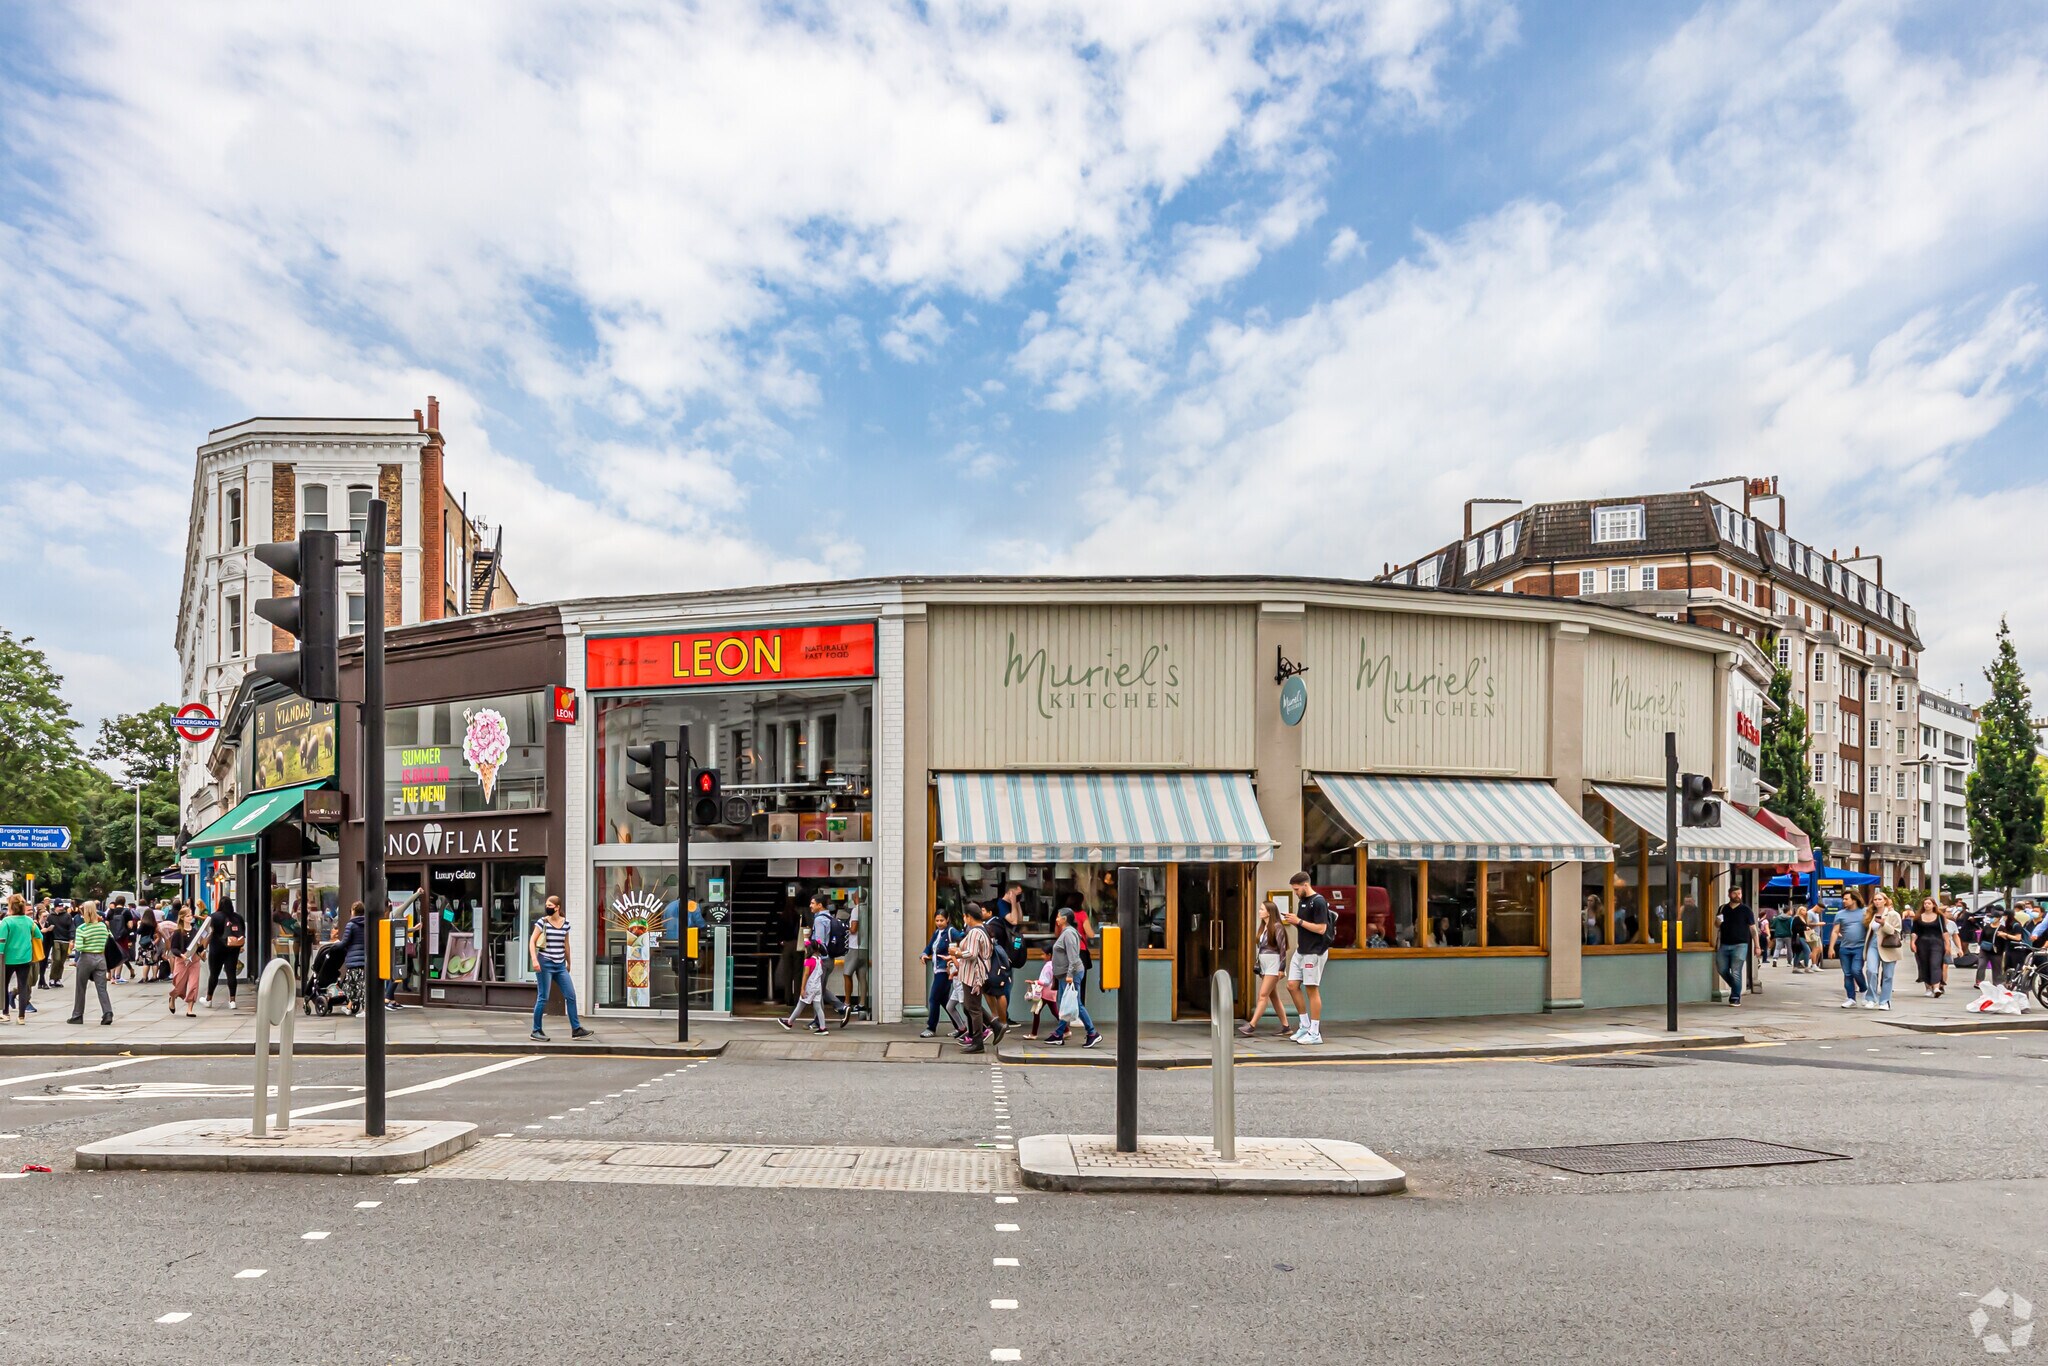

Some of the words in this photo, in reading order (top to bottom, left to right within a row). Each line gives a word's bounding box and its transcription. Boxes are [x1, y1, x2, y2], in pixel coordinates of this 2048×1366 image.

[673, 634, 782, 678] LEON
[805, 643, 849, 652] NATURALLY
[805, 652, 823, 660] FAST
[826, 651, 849, 659] FOOD
[1004, 632, 1179, 719] Muriel's
[1356, 636, 1494, 724] Muriel's
[1050, 692, 1180, 709] KITCHEN
[1610, 657, 1686, 739] Muriel's
[277, 701, 310, 725] VIANDAS
[556, 708, 574, 719] LEON
[1393, 698, 1495, 718] KITCHEN
[172, 718, 220, 726] UNDERGROUND
[402, 747, 441, 766] SUMMER
[402, 768, 411, 785] IS
[412, 767, 435, 784] BACK
[437, 765, 450, 782] ON
[402, 786, 419, 803] THE
[420, 784, 447, 802] MENU
[383, 823, 519, 856] NOWFLAKE
[435, 871, 455, 881] Luxury
[455, 870, 476, 879] Gelato
[612, 890, 664, 915] HALLOU
[626, 908, 640, 920] IT'S
